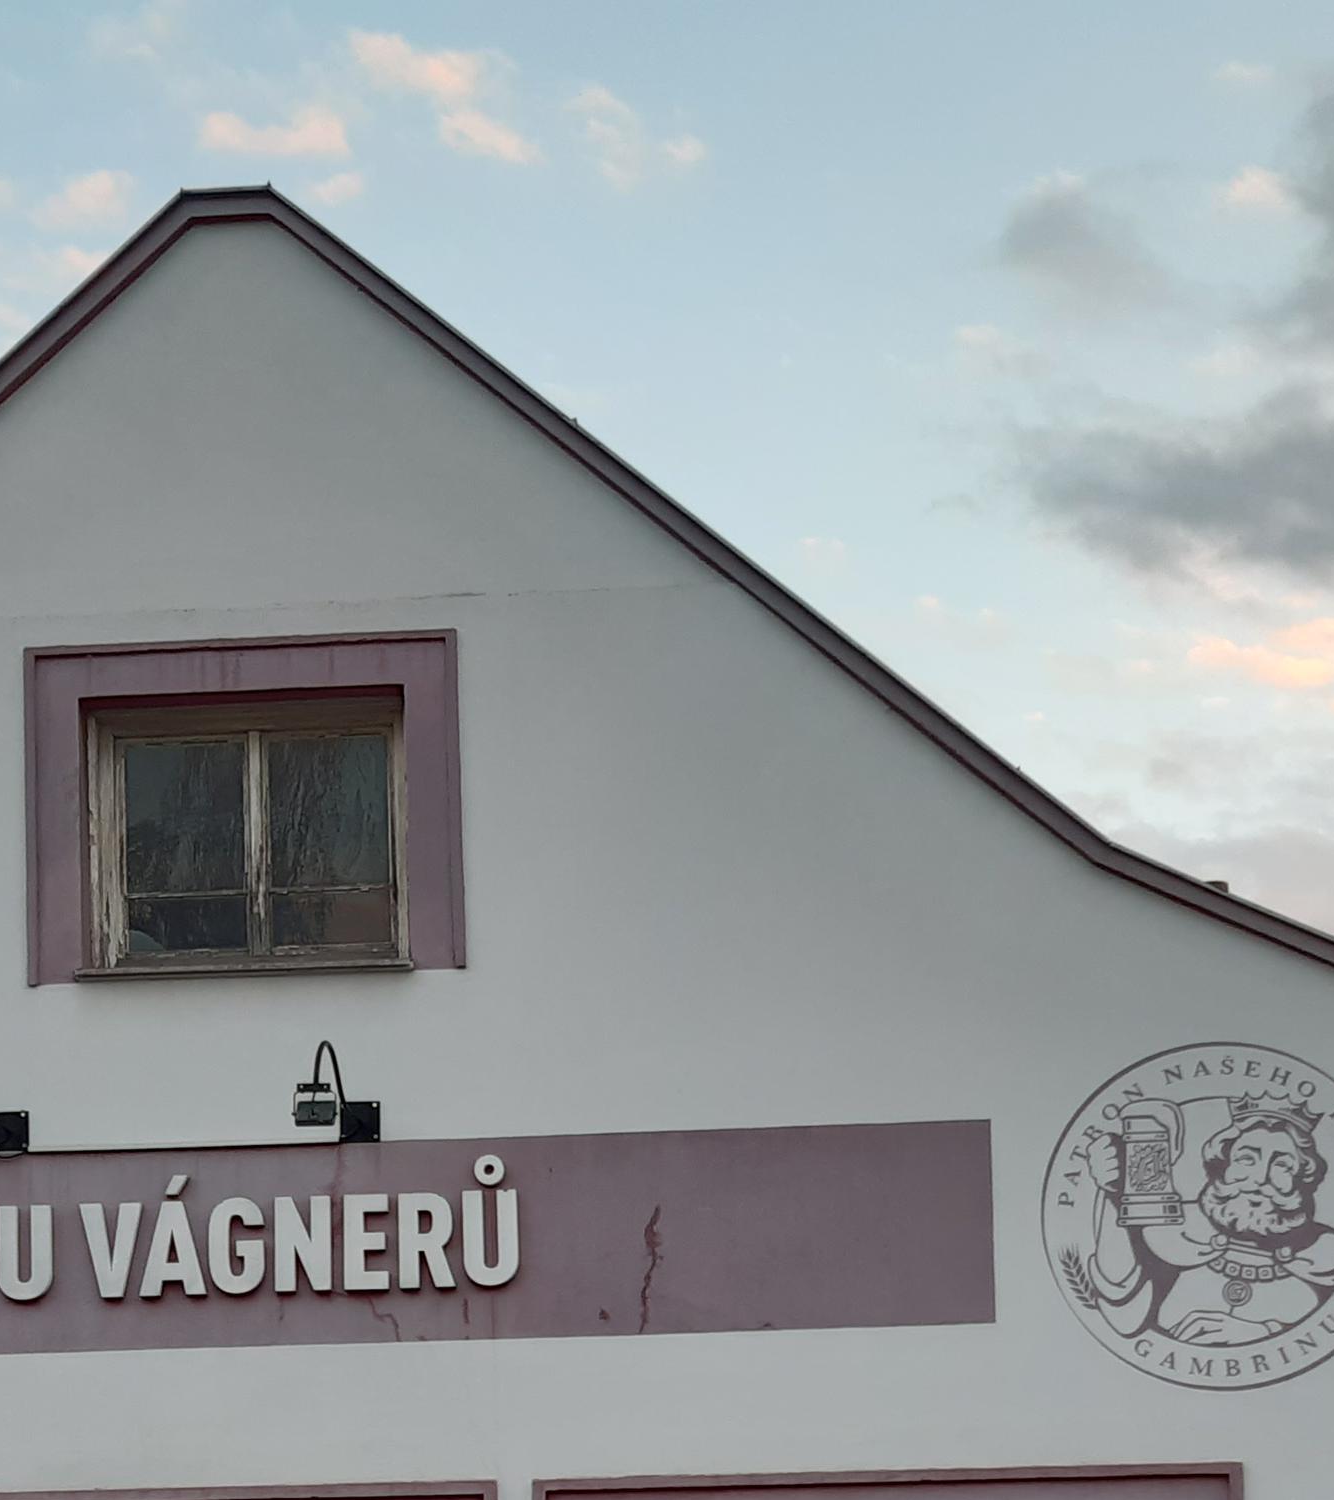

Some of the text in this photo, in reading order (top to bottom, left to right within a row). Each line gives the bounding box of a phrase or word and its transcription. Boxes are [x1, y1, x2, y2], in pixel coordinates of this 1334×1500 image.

[1057, 1082, 1145, 1208] PATRON
[1161, 1055, 1317, 1099] NAŠEHO
[79, 1153, 522, 1300] VÁGNERŮ
